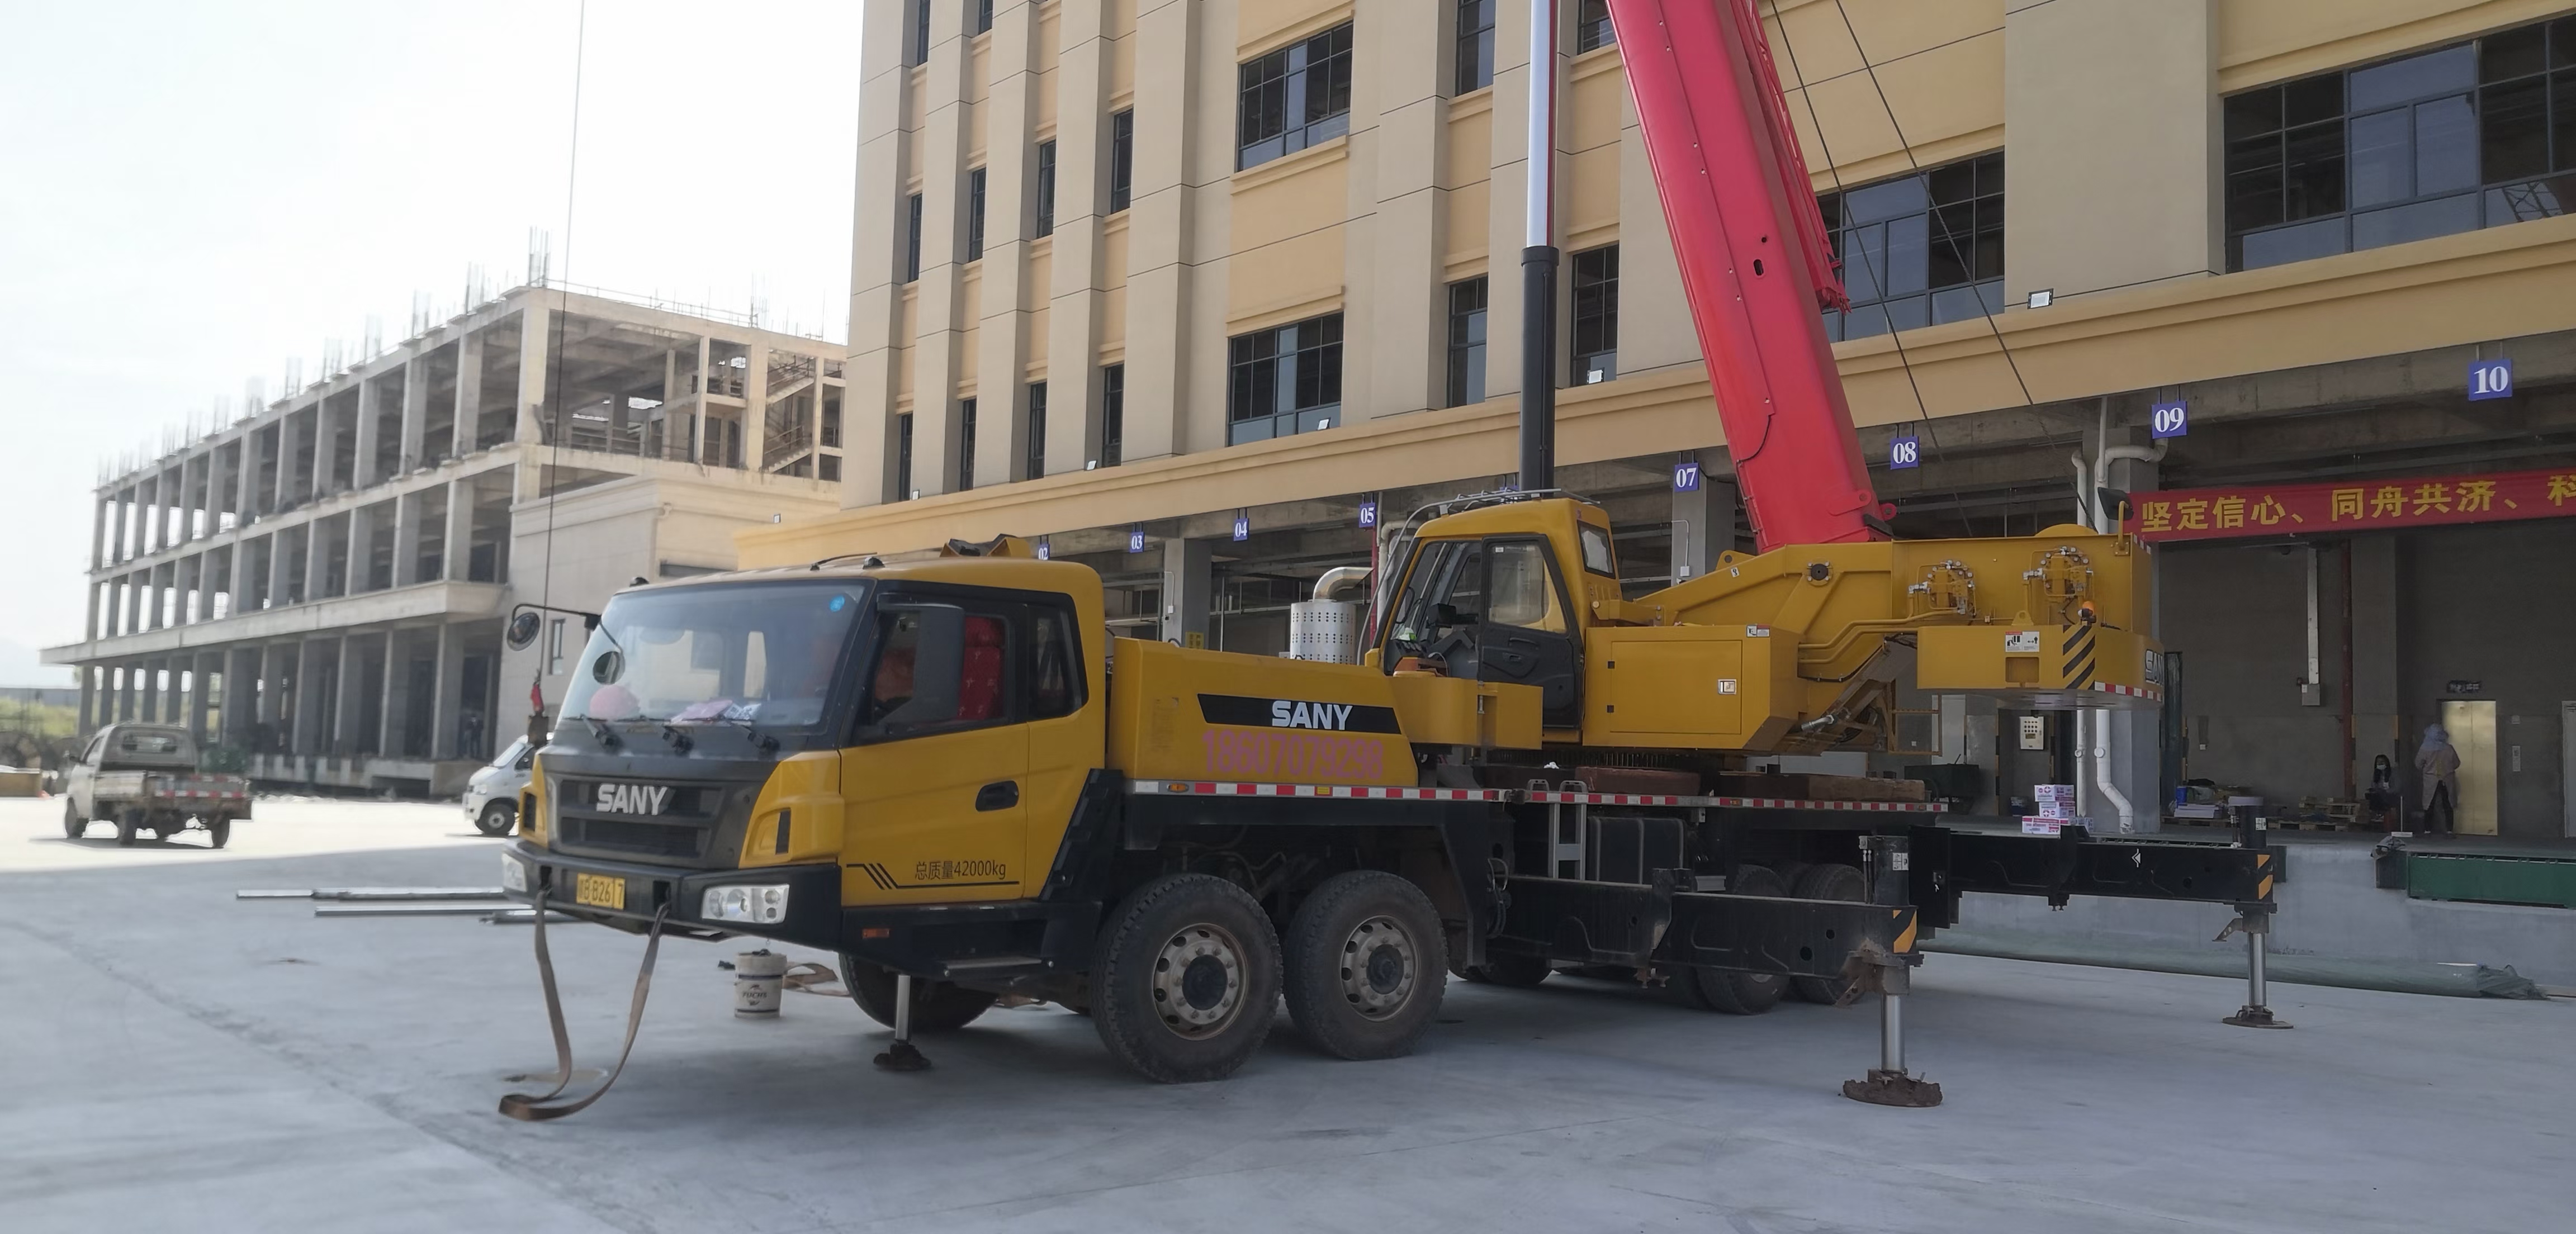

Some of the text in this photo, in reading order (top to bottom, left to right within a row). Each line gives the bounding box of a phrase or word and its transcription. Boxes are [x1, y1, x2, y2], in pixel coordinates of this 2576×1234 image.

[2474, 366, 2508, 394] 10
[2154, 407, 2185, 433] 09
[1893, 442, 1916, 464] 08
[1676, 467, 1697, 487] 07
[1360, 507, 1374, 523] 05
[1235, 521, 1247, 537] 04
[1131, 535, 1143, 550] 03
[1038, 548, 1048, 560] 02
[1272, 701, 1353, 730] SANY
[1202, 729, 1384, 779] 18607079298
[596, 784, 668, 816] SANY
[915, 860, 1006, 880] 总质量42000kg
